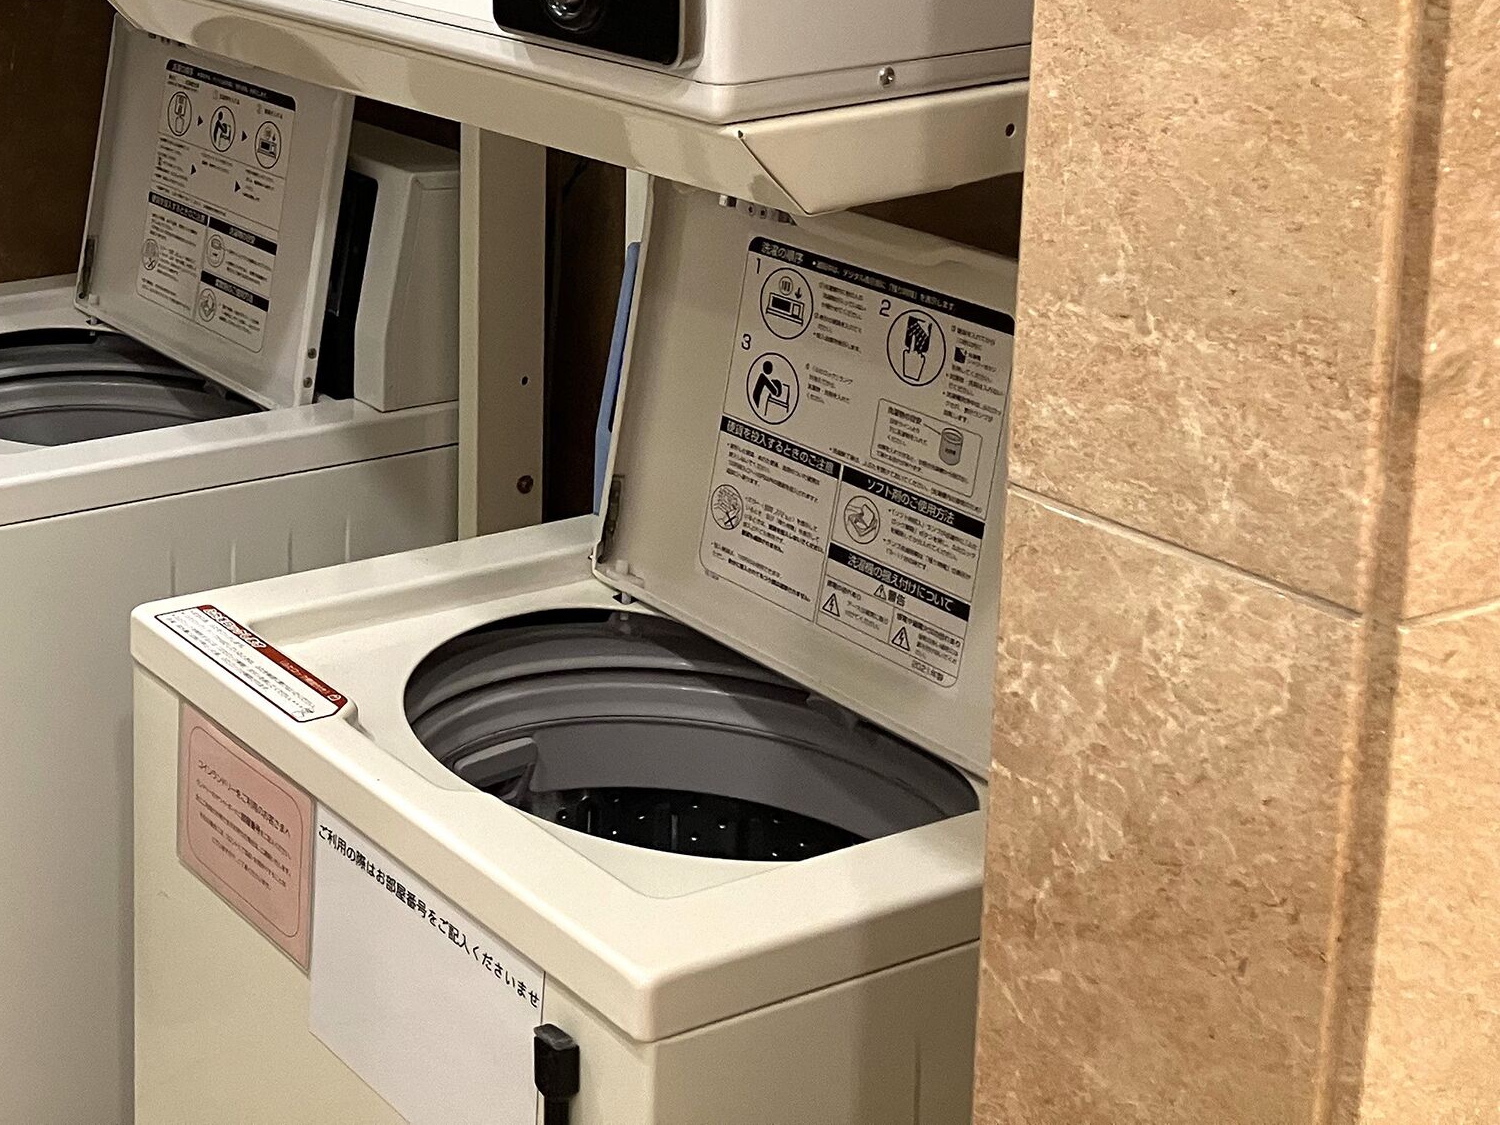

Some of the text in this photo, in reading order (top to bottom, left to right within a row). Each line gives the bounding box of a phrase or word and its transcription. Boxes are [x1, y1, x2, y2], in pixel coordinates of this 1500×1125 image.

[756, 257, 761, 274] 1
[879, 299, 892, 317] 2
[741, 333, 752, 350] 3
[726, 420, 834, 475] 硬貨を投入するときのご注意
[867, 478, 956, 525] ソフト剤のご使用方法
[847, 554, 954, 612] 洗濯機の据え付けについて
[887, 589, 906, 607] 警告
[318, 823, 540, 1009] ご利用の際はお部屋番号をご記入くださいませ
